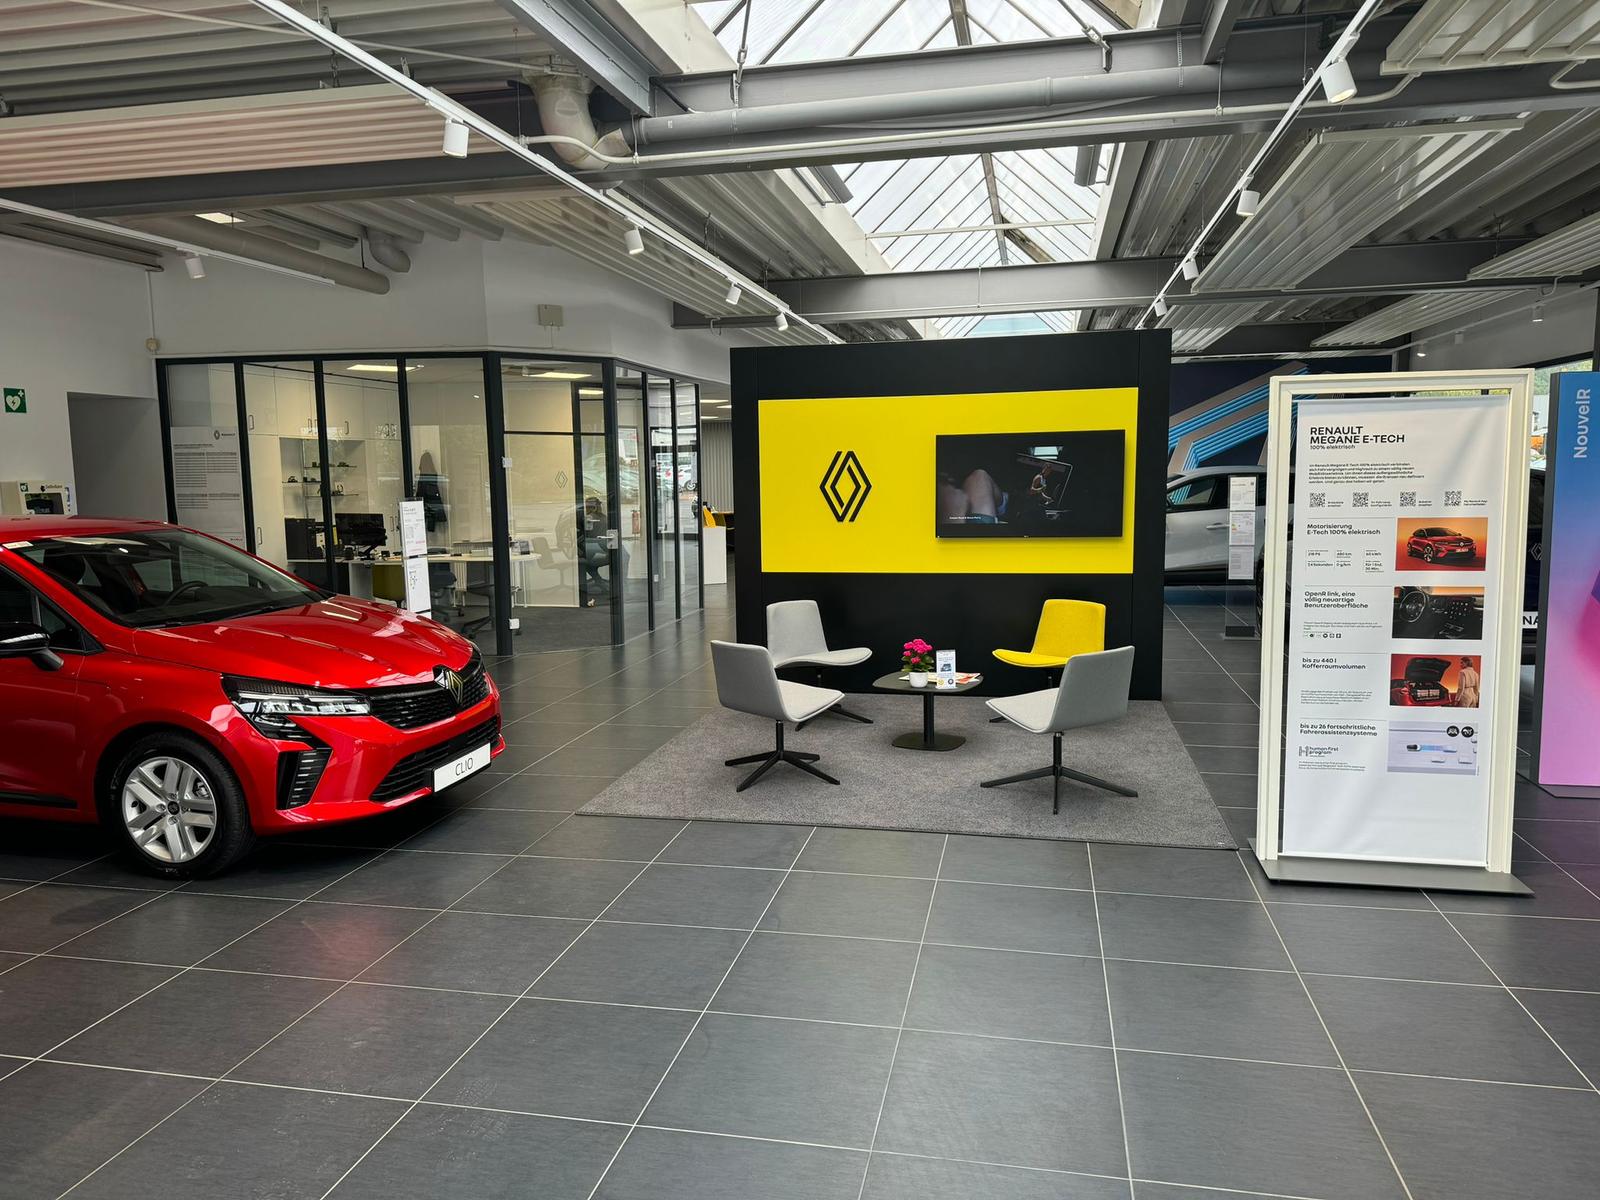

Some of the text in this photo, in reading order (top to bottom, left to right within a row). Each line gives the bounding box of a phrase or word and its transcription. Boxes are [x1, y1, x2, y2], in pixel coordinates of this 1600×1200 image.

[1574, 388, 1590, 458] NouvelR
[1310, 426, 1363, 435] RENAULT
[1310, 435, 1404, 444] MEGANE E-TECH
[456, 758, 474, 776] CLIO
